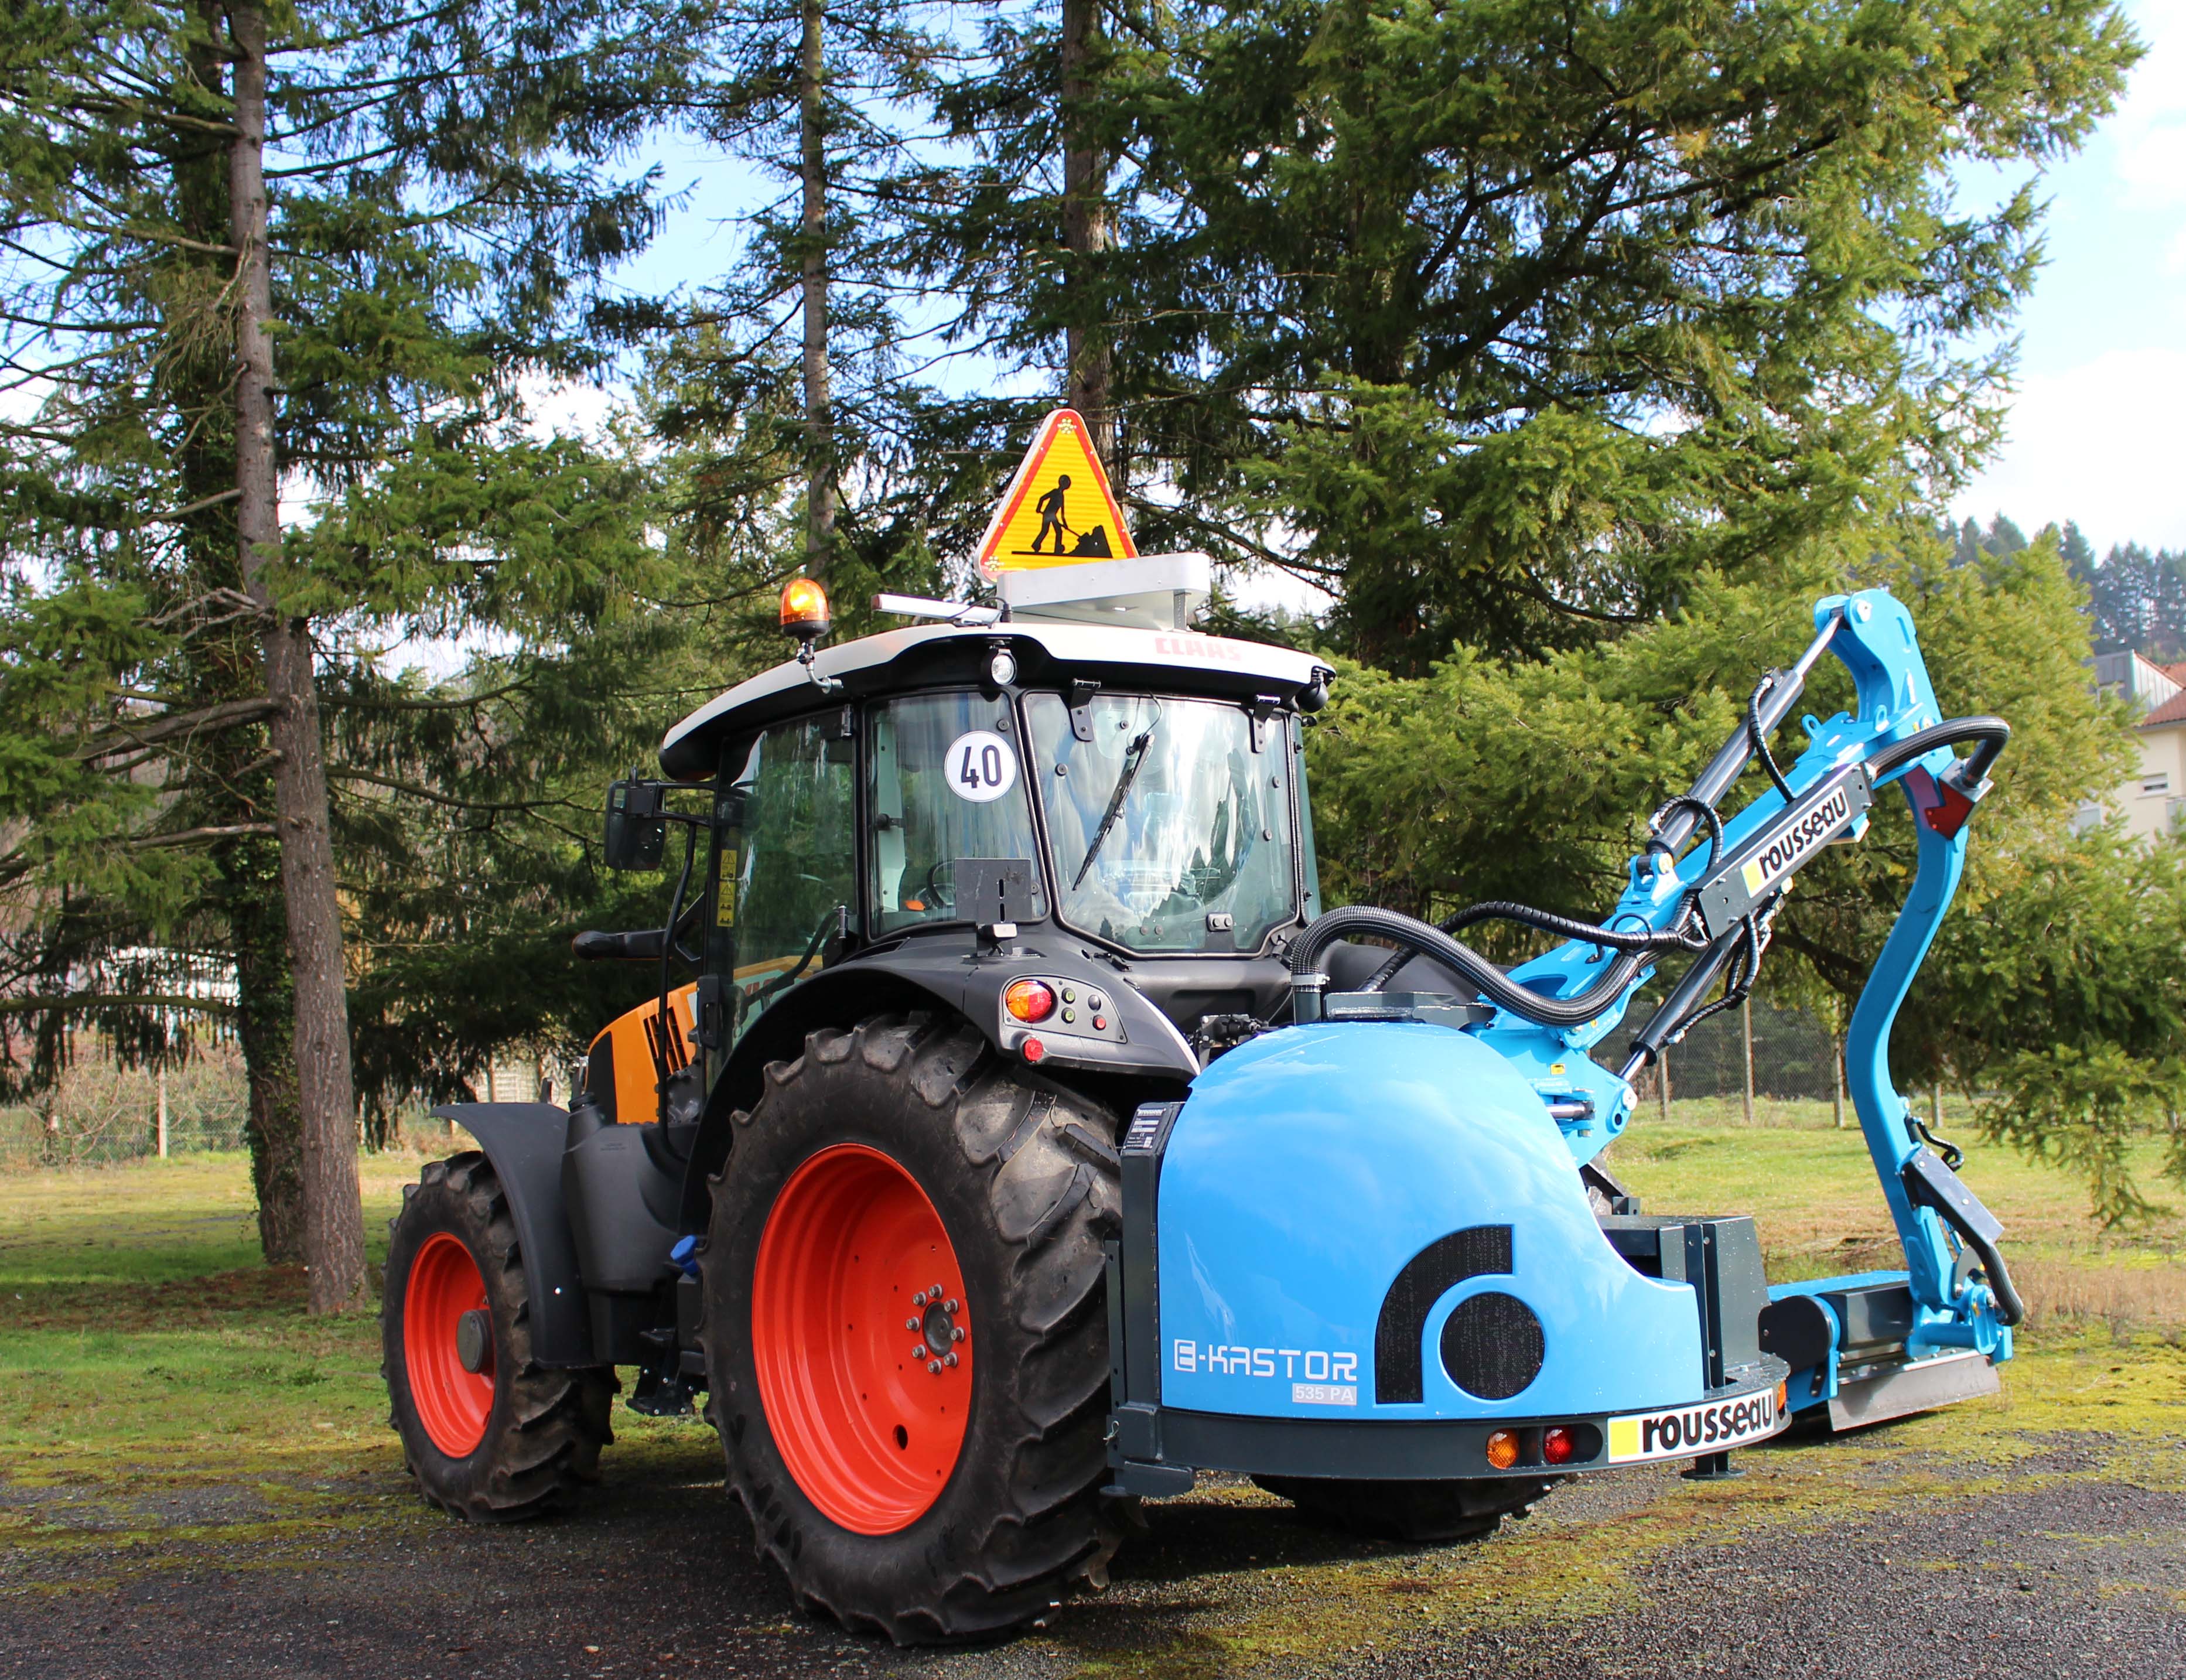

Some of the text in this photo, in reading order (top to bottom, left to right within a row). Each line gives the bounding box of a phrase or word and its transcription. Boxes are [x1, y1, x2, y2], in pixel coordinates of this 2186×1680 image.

[1155, 637, 1241, 661] CLAAS
[960, 745, 1002, 788] 40
[1759, 792, 1846, 880] rousseau
[1296, 1385, 1354, 1402] 535 PA
[1642, 1394, 1772, 1453] rousseau
